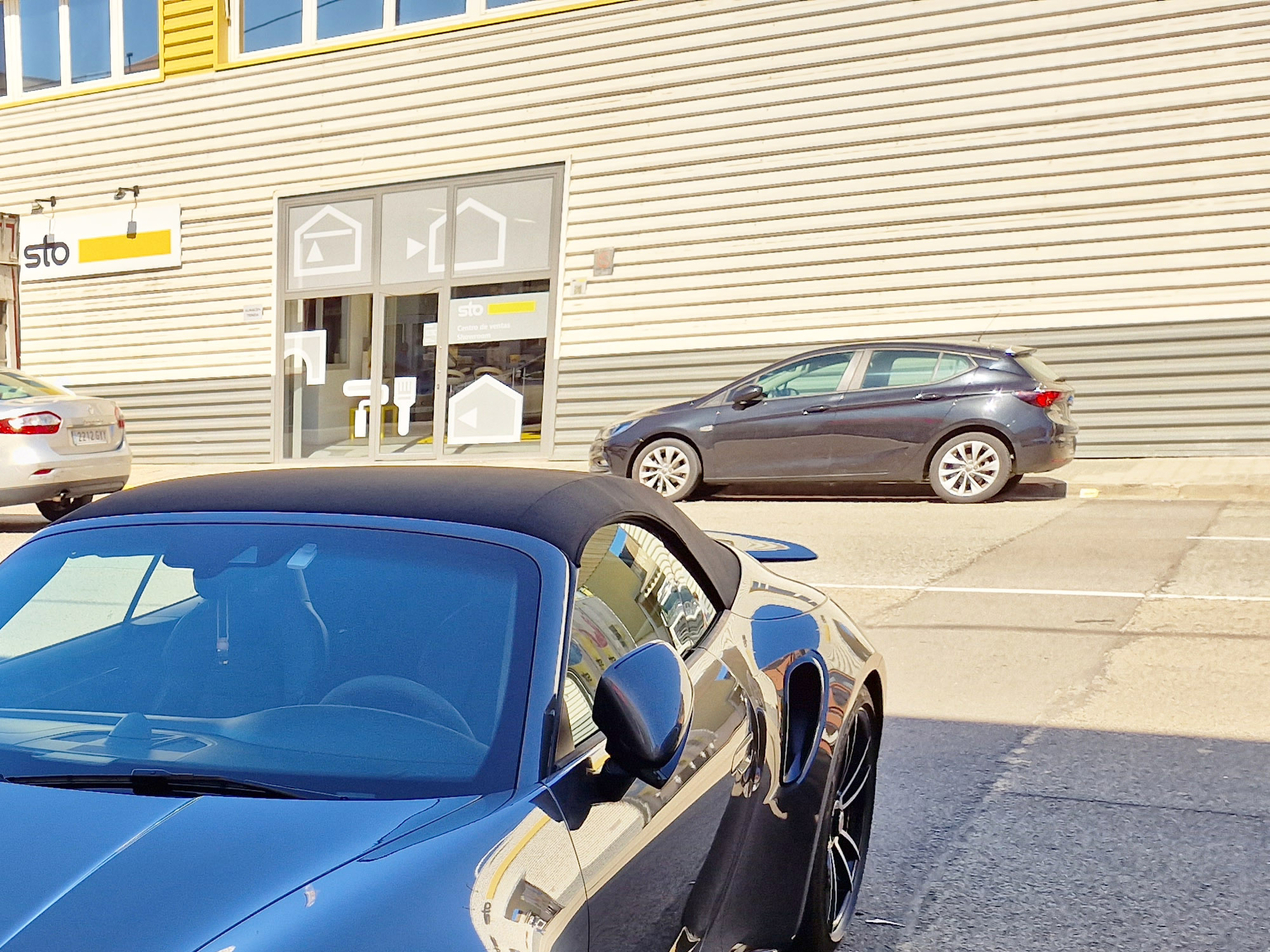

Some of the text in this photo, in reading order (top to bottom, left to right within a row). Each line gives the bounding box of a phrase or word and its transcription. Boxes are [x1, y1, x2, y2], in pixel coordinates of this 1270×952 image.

[24, 235, 70, 268] sto
[458, 301, 484, 317] sto
[457, 324, 478, 332] Centro
[490, 322, 511, 330] ventas
[457, 333, 492, 341] Showroom
